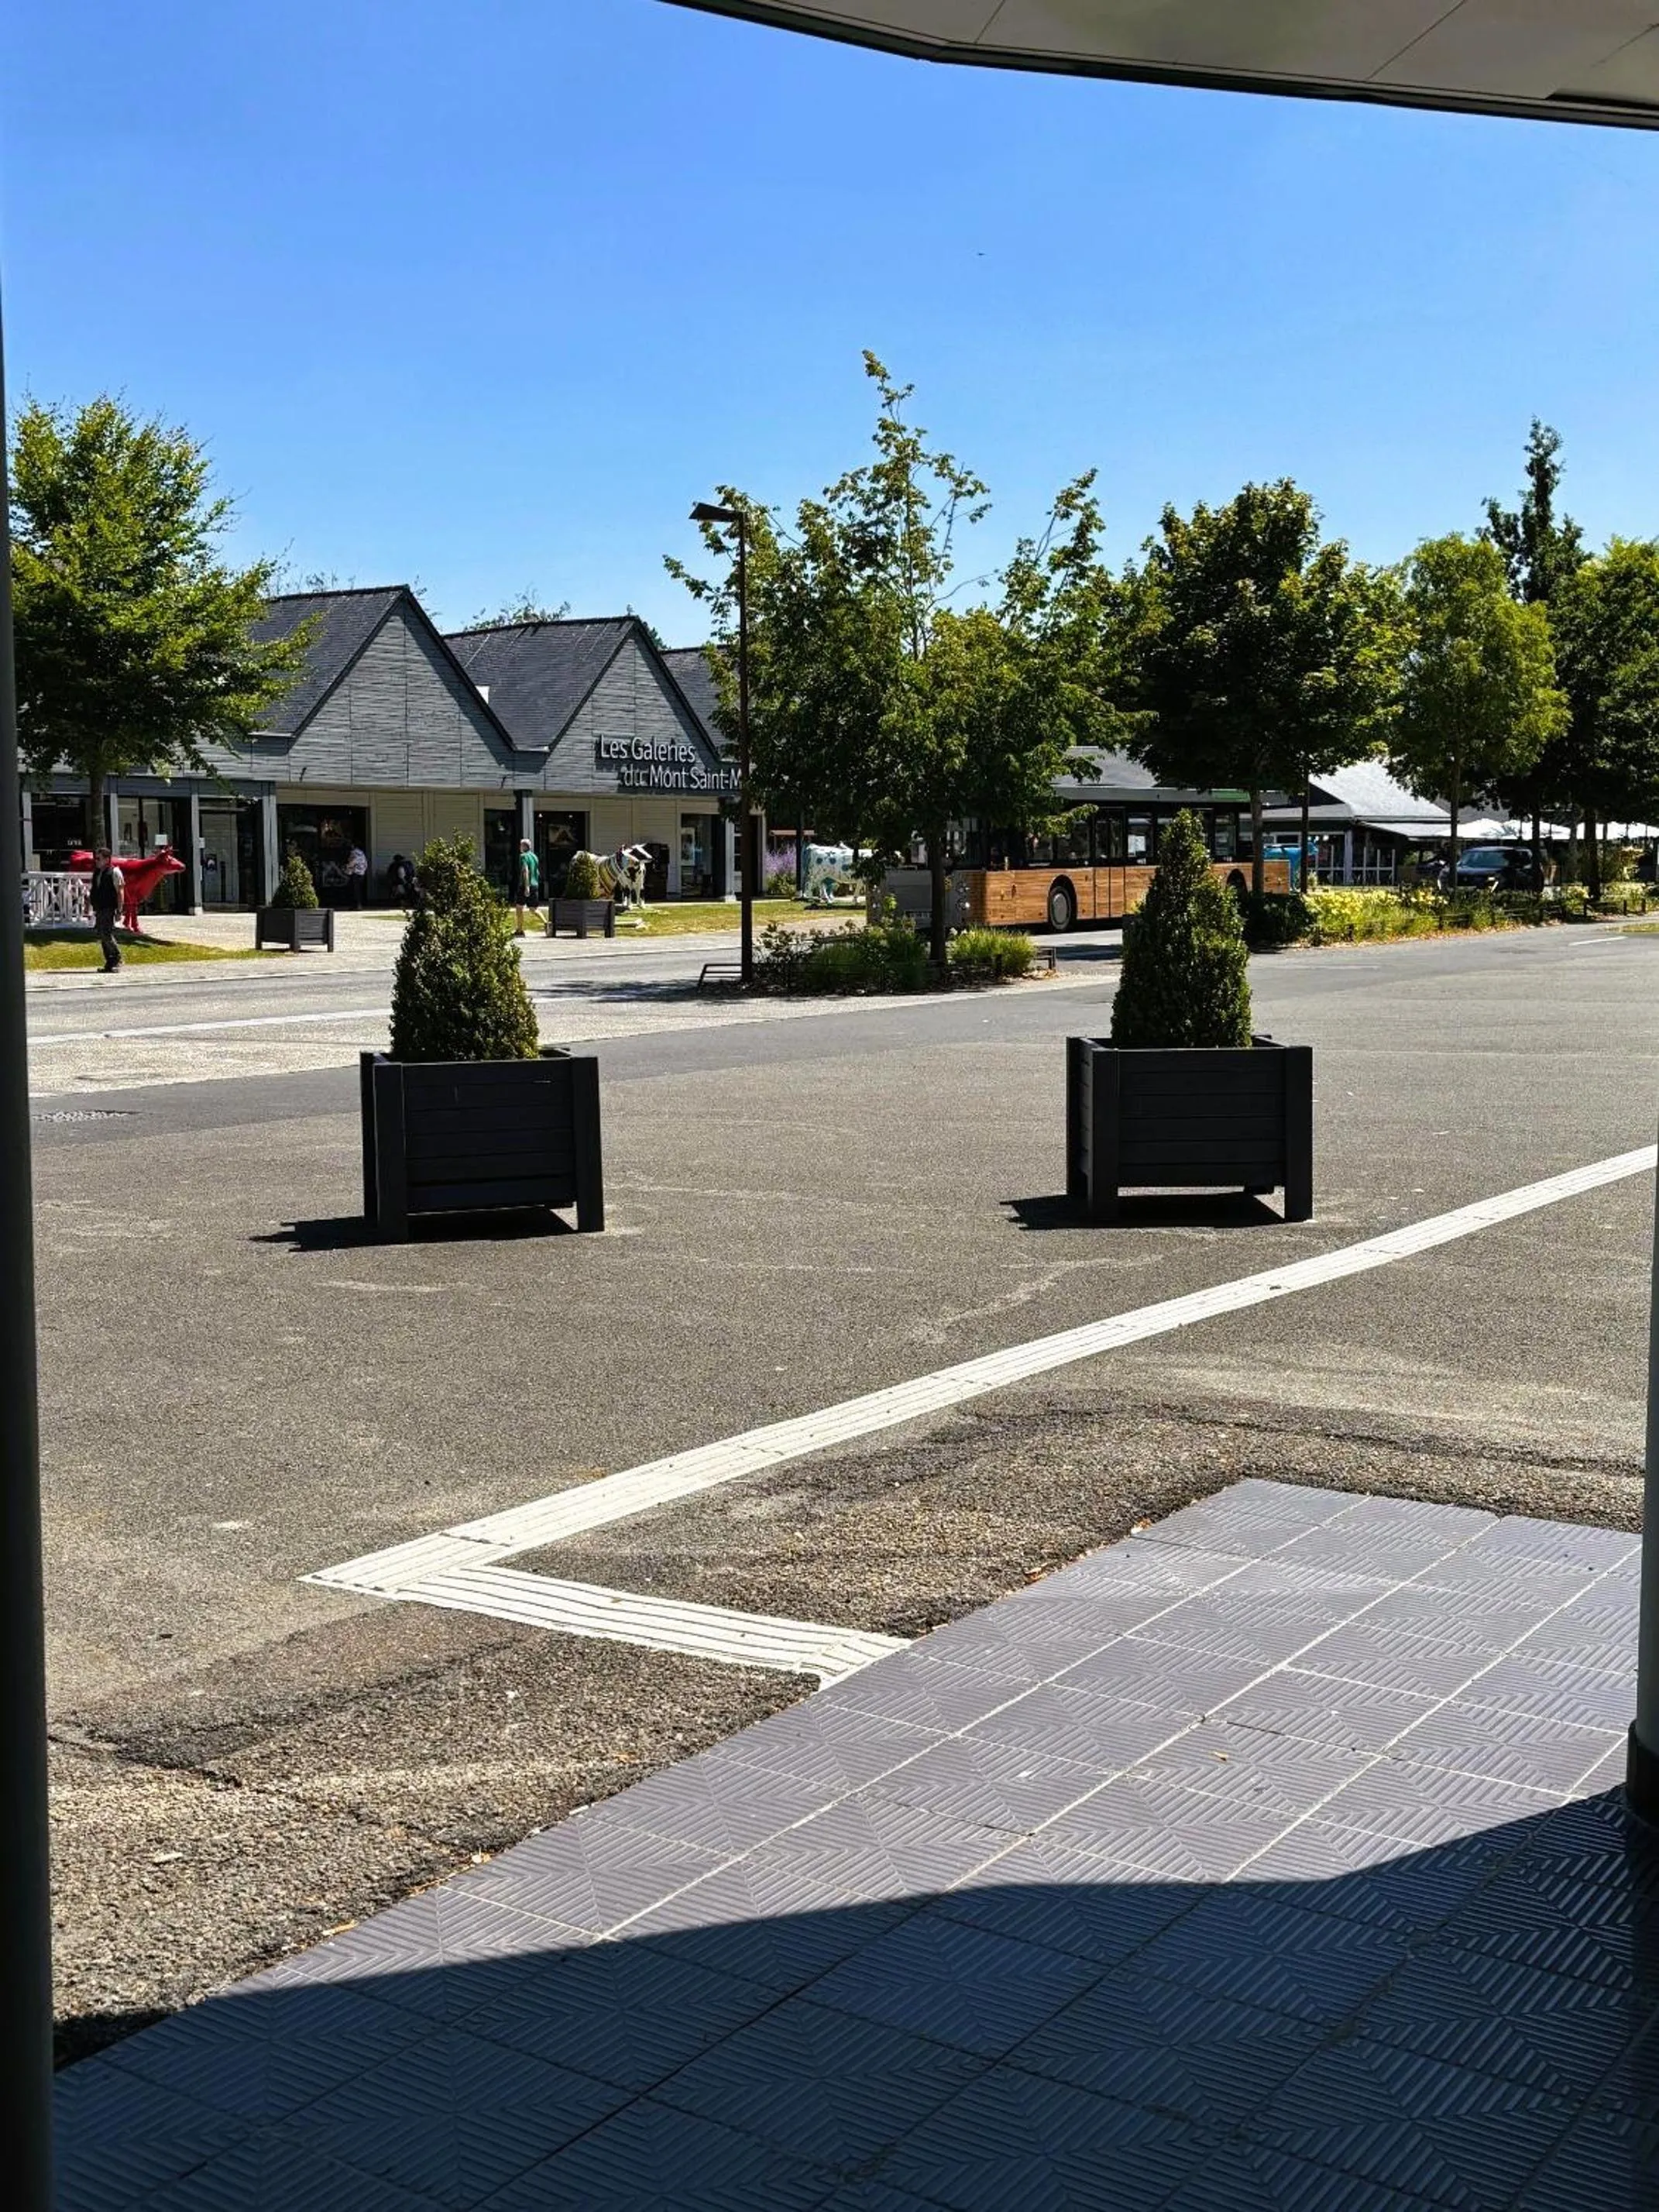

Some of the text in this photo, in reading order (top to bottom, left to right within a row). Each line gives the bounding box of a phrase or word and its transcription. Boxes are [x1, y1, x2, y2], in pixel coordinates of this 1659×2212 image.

[600, 734, 696, 762] Les Galeries
[623, 763, 741, 790] du Mont Saint-M
